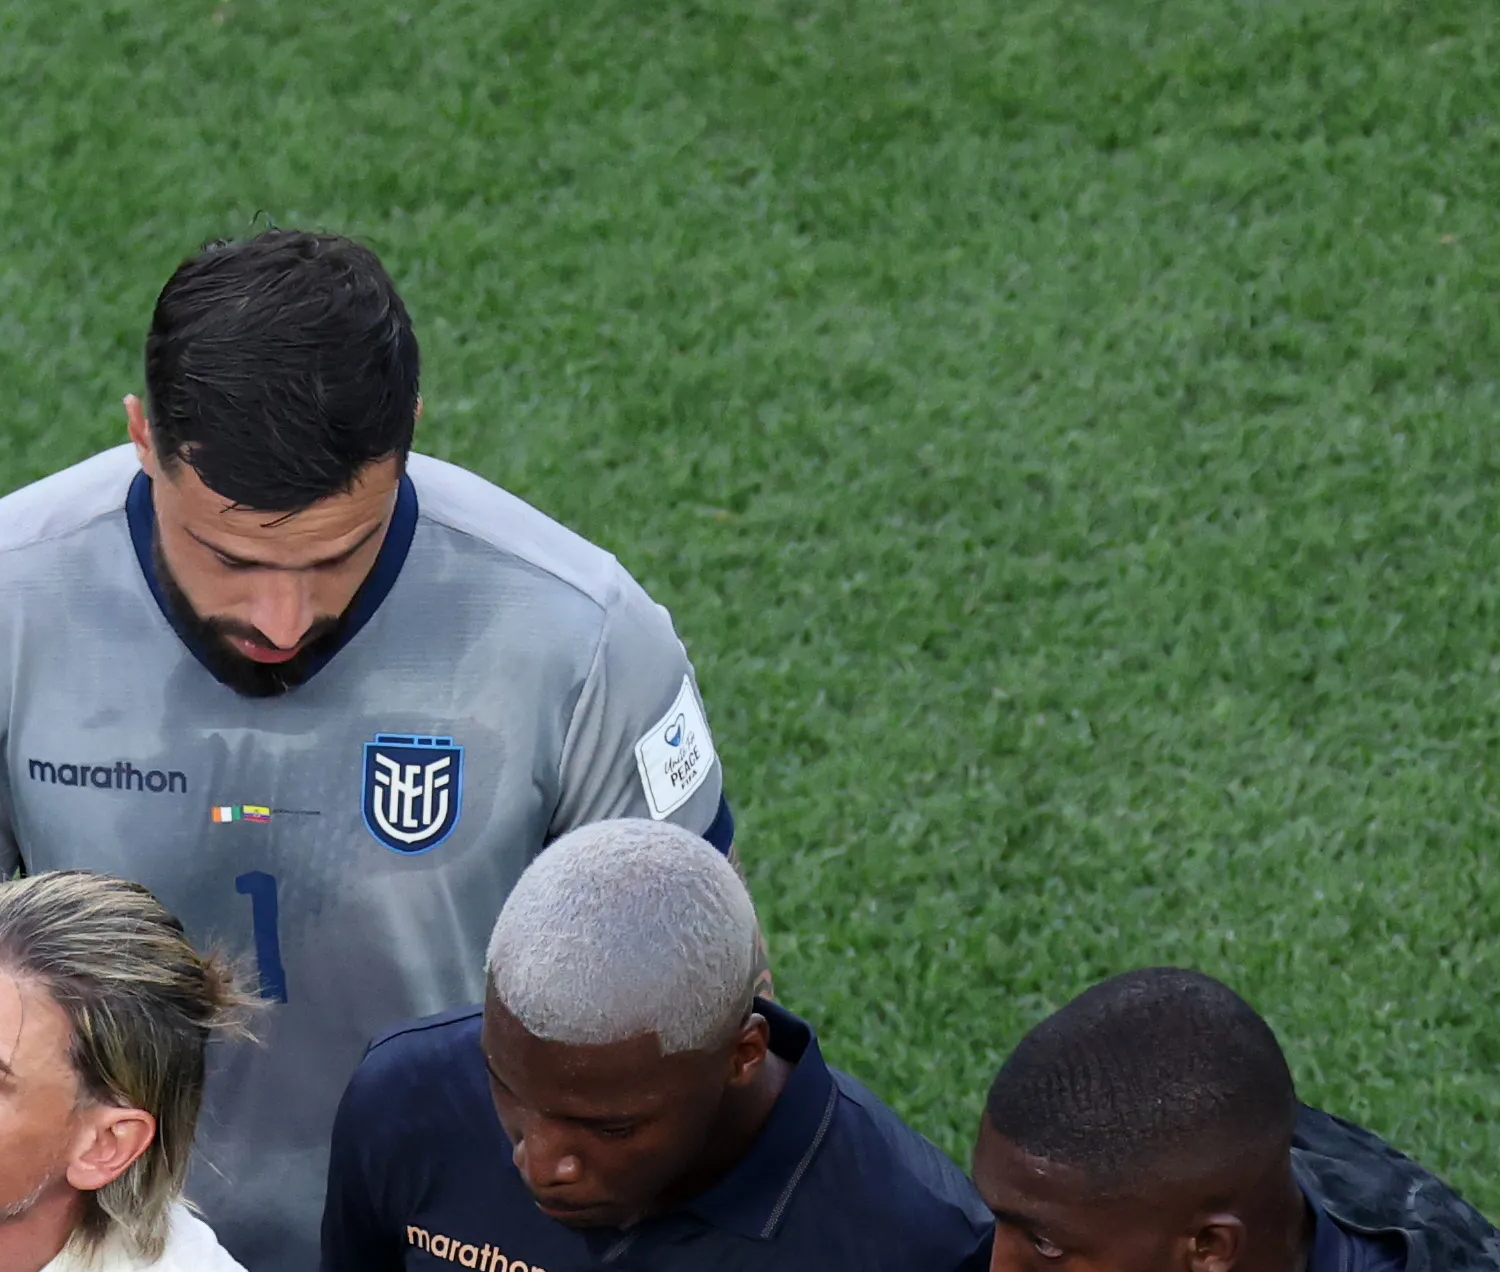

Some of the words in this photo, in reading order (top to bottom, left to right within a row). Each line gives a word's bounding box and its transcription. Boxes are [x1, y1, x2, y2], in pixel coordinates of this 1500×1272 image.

[28, 757, 188, 795] marathon
[670, 747, 702, 788] PEACE
[681, 767, 698, 790] FIFA
[234, 870, 289, 1005] 1
